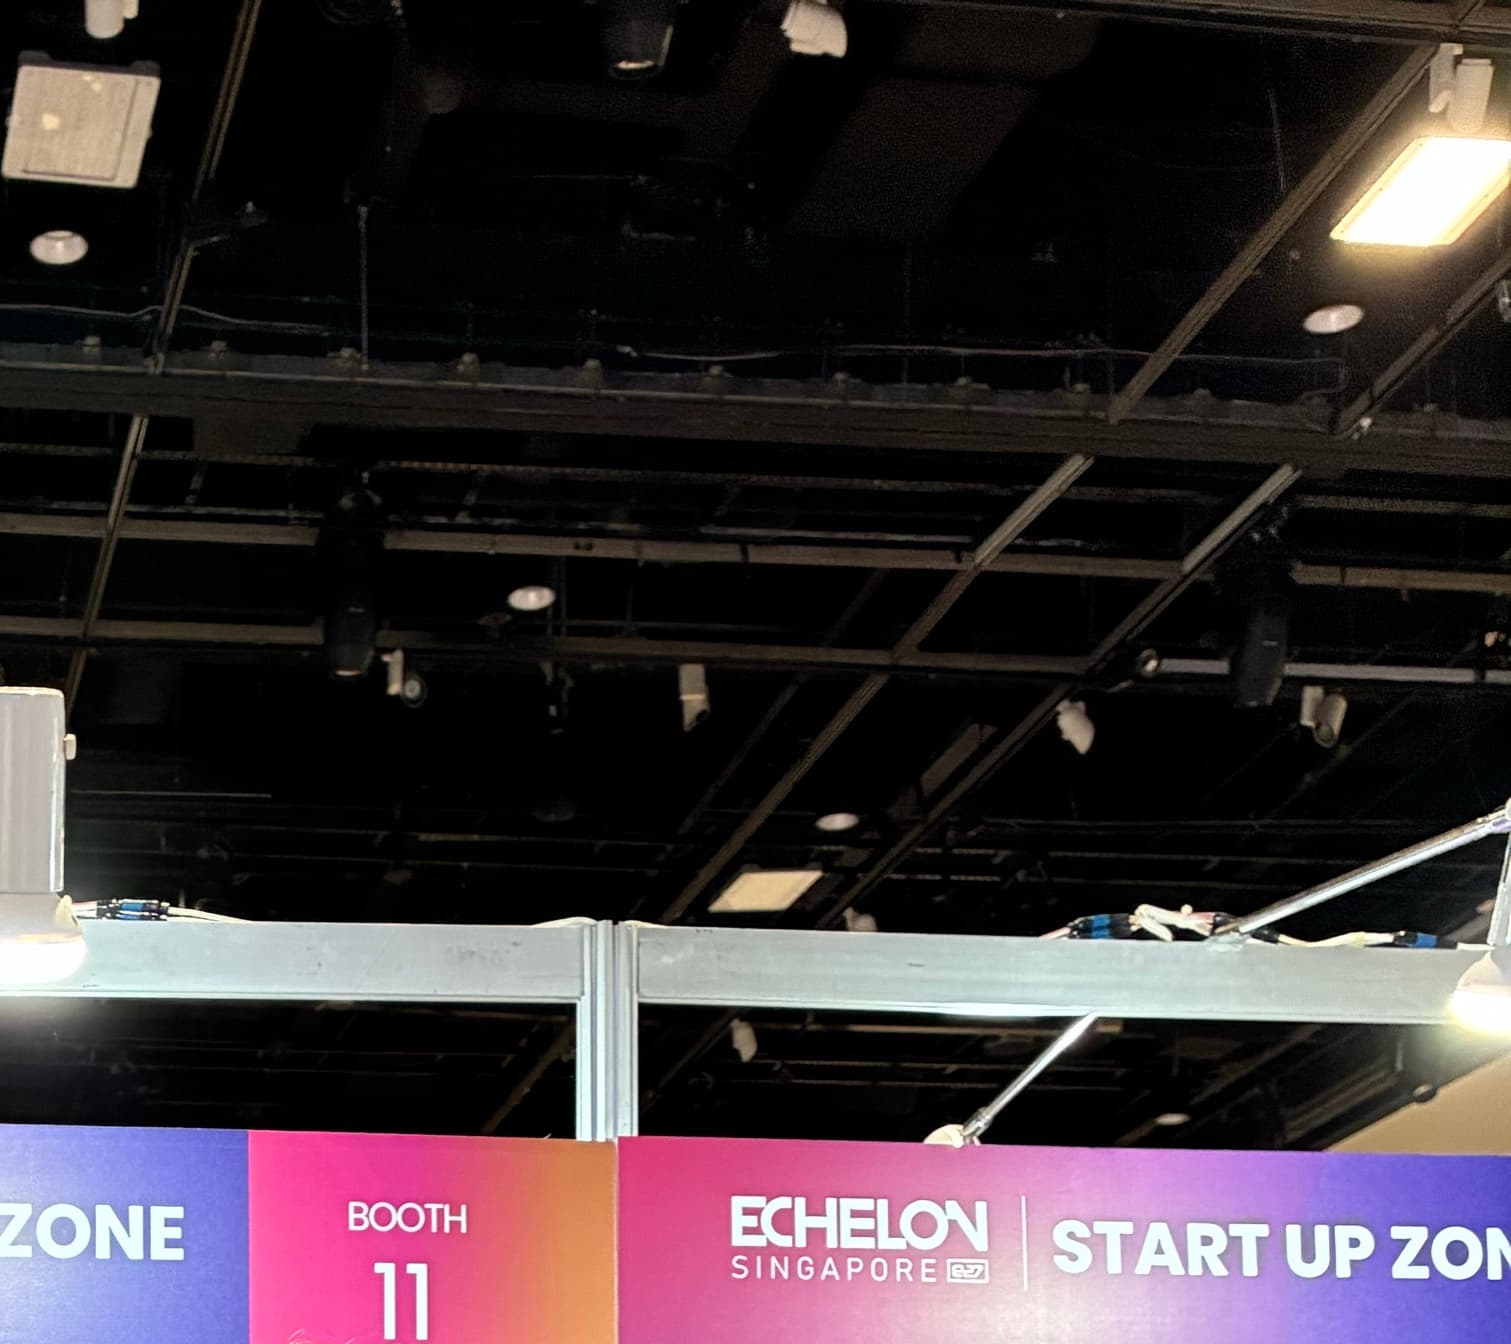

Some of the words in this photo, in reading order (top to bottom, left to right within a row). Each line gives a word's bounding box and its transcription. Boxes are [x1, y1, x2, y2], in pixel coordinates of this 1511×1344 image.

[347, 1201, 467, 1233] BOOTH
[731, 1195, 987, 1251] ECHELON
[731, 1255, 937, 1282] SINGAPORE
[1053, 1219, 1268, 1279] START
[1284, 1224, 1375, 1279] UP
[373, 1262, 429, 1341] 11
